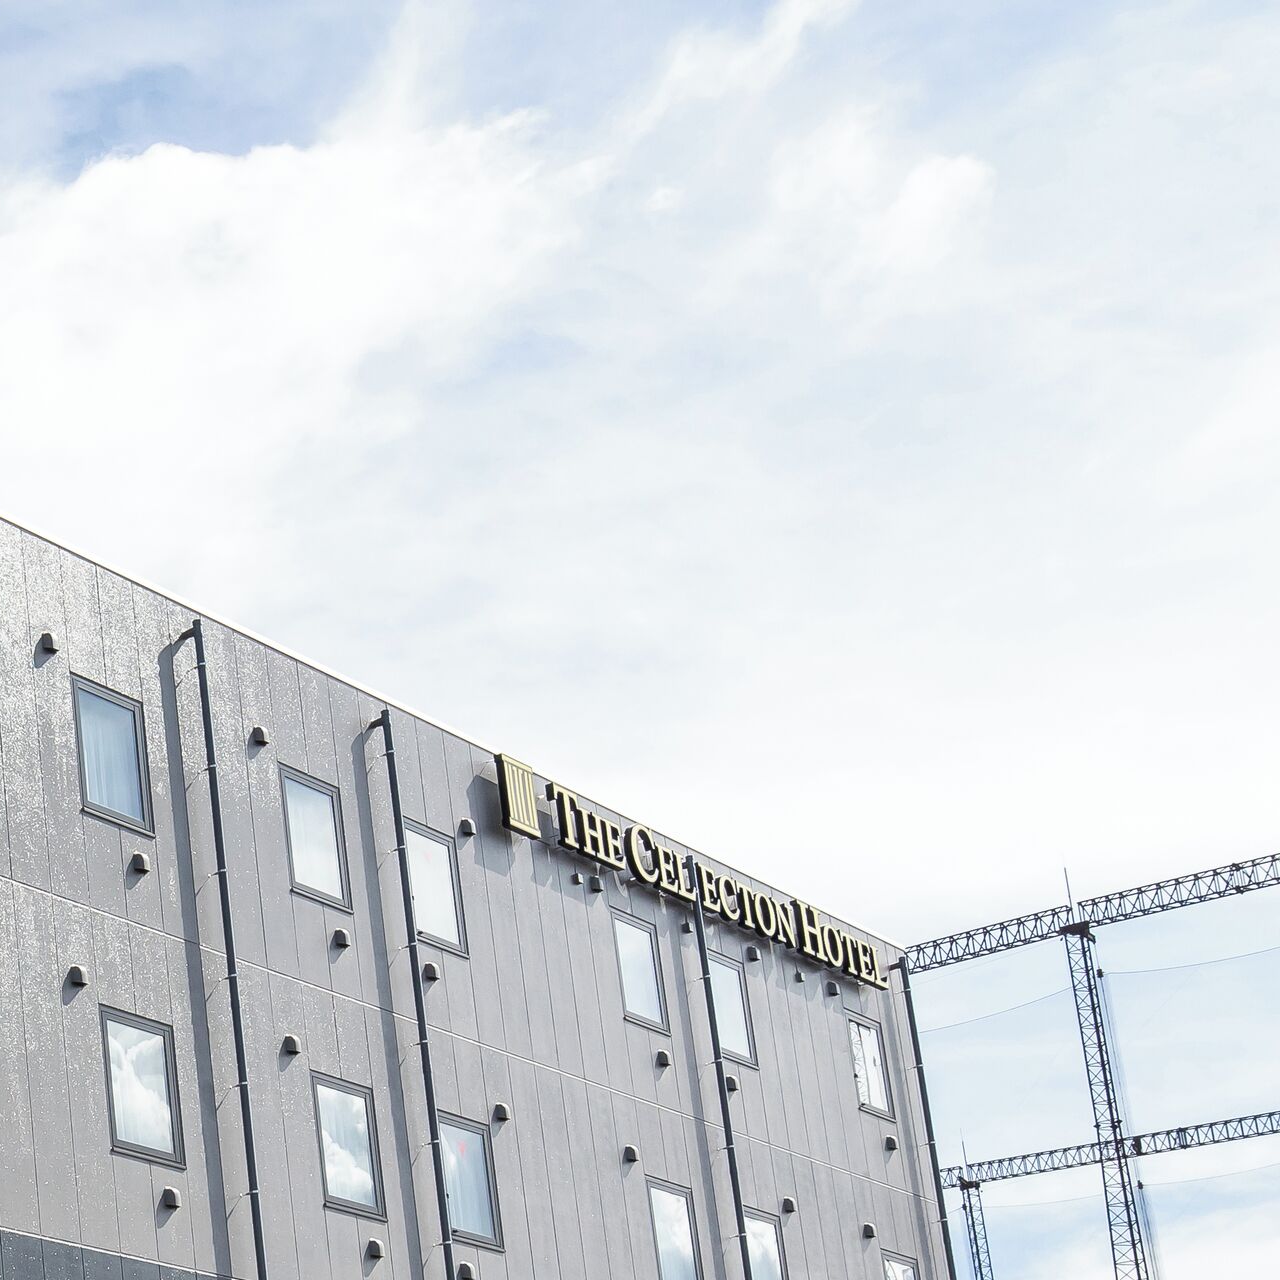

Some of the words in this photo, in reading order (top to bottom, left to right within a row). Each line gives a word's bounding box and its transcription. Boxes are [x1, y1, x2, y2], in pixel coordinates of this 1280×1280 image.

[554, 783, 625, 868] THE
[629, 824, 797, 948] CELECTON
[799, 901, 889, 988] HOTEL
